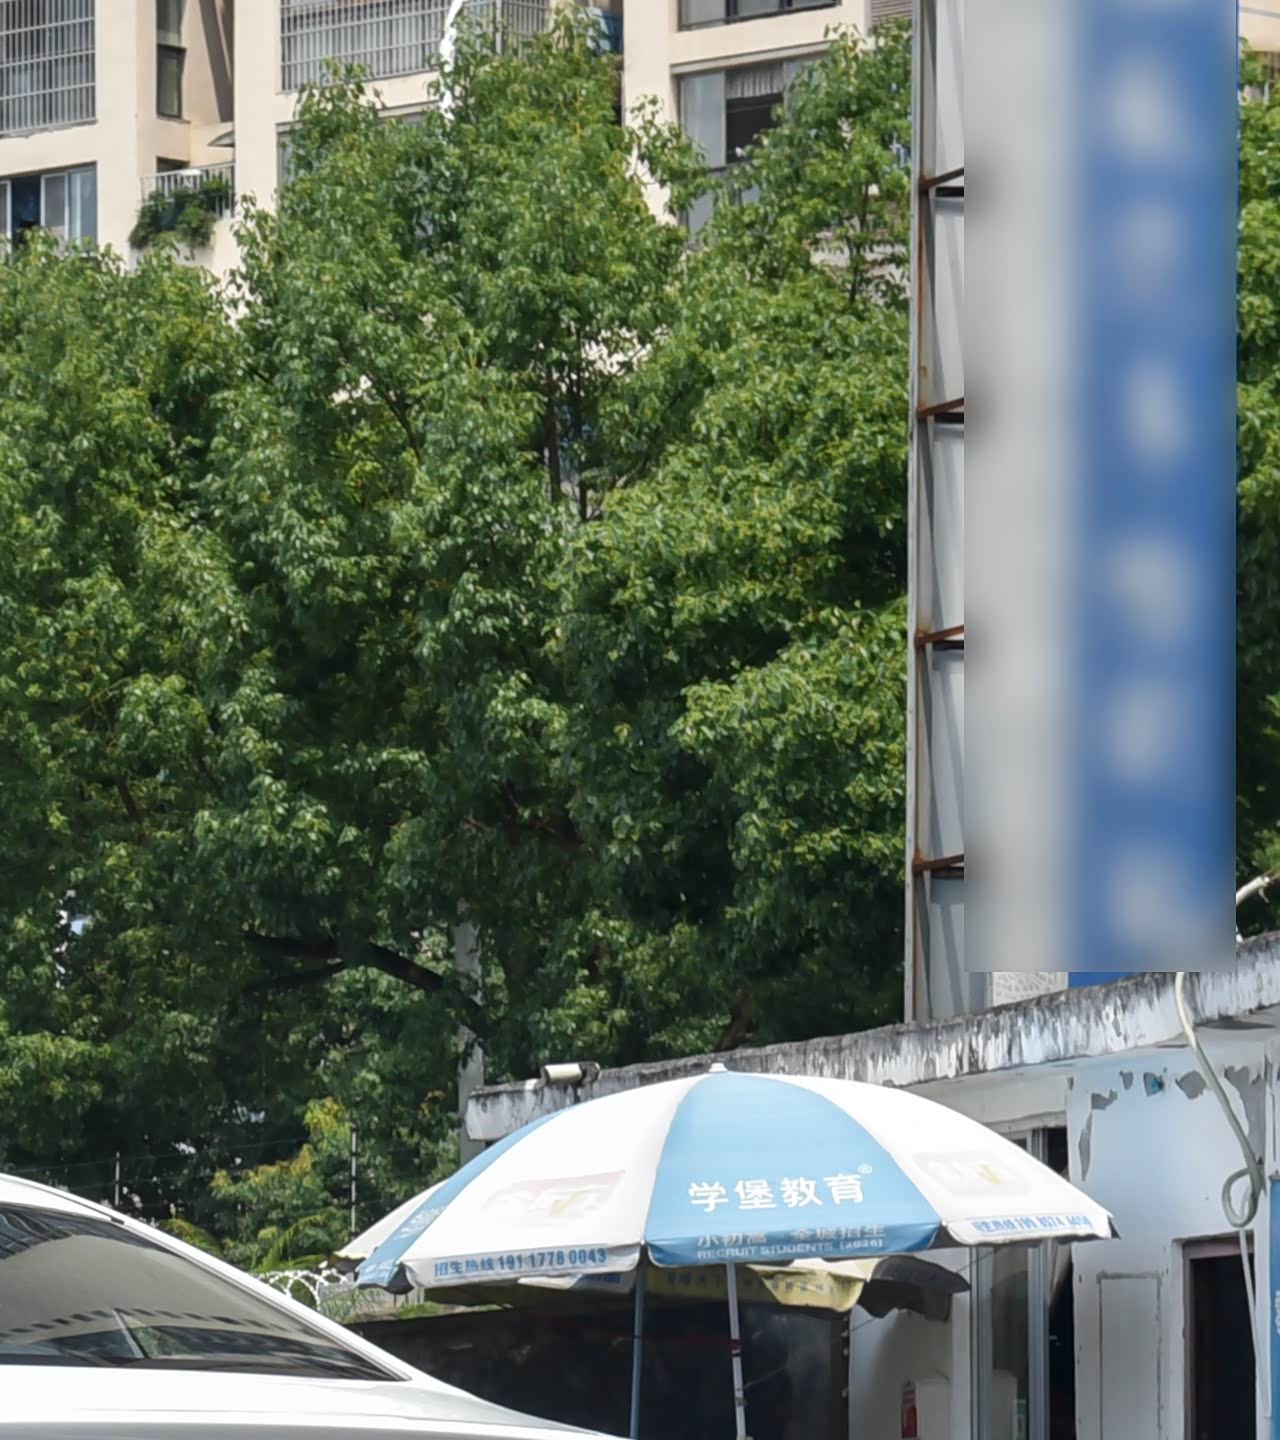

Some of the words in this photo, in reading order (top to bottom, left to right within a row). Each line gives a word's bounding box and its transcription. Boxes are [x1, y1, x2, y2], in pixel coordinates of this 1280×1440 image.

[688, 1171, 865, 1213] 学堡教育
[434, 1257, 495, 1277] 招生热线
[497, 1254, 523, 1271] 191
[529, 1250, 565, 1269] 1778
[568, 1247, 607, 1265] 0043
[697, 1246, 756, 1260] RECRUIT
[760, 1242, 833, 1255] STUDENTS
